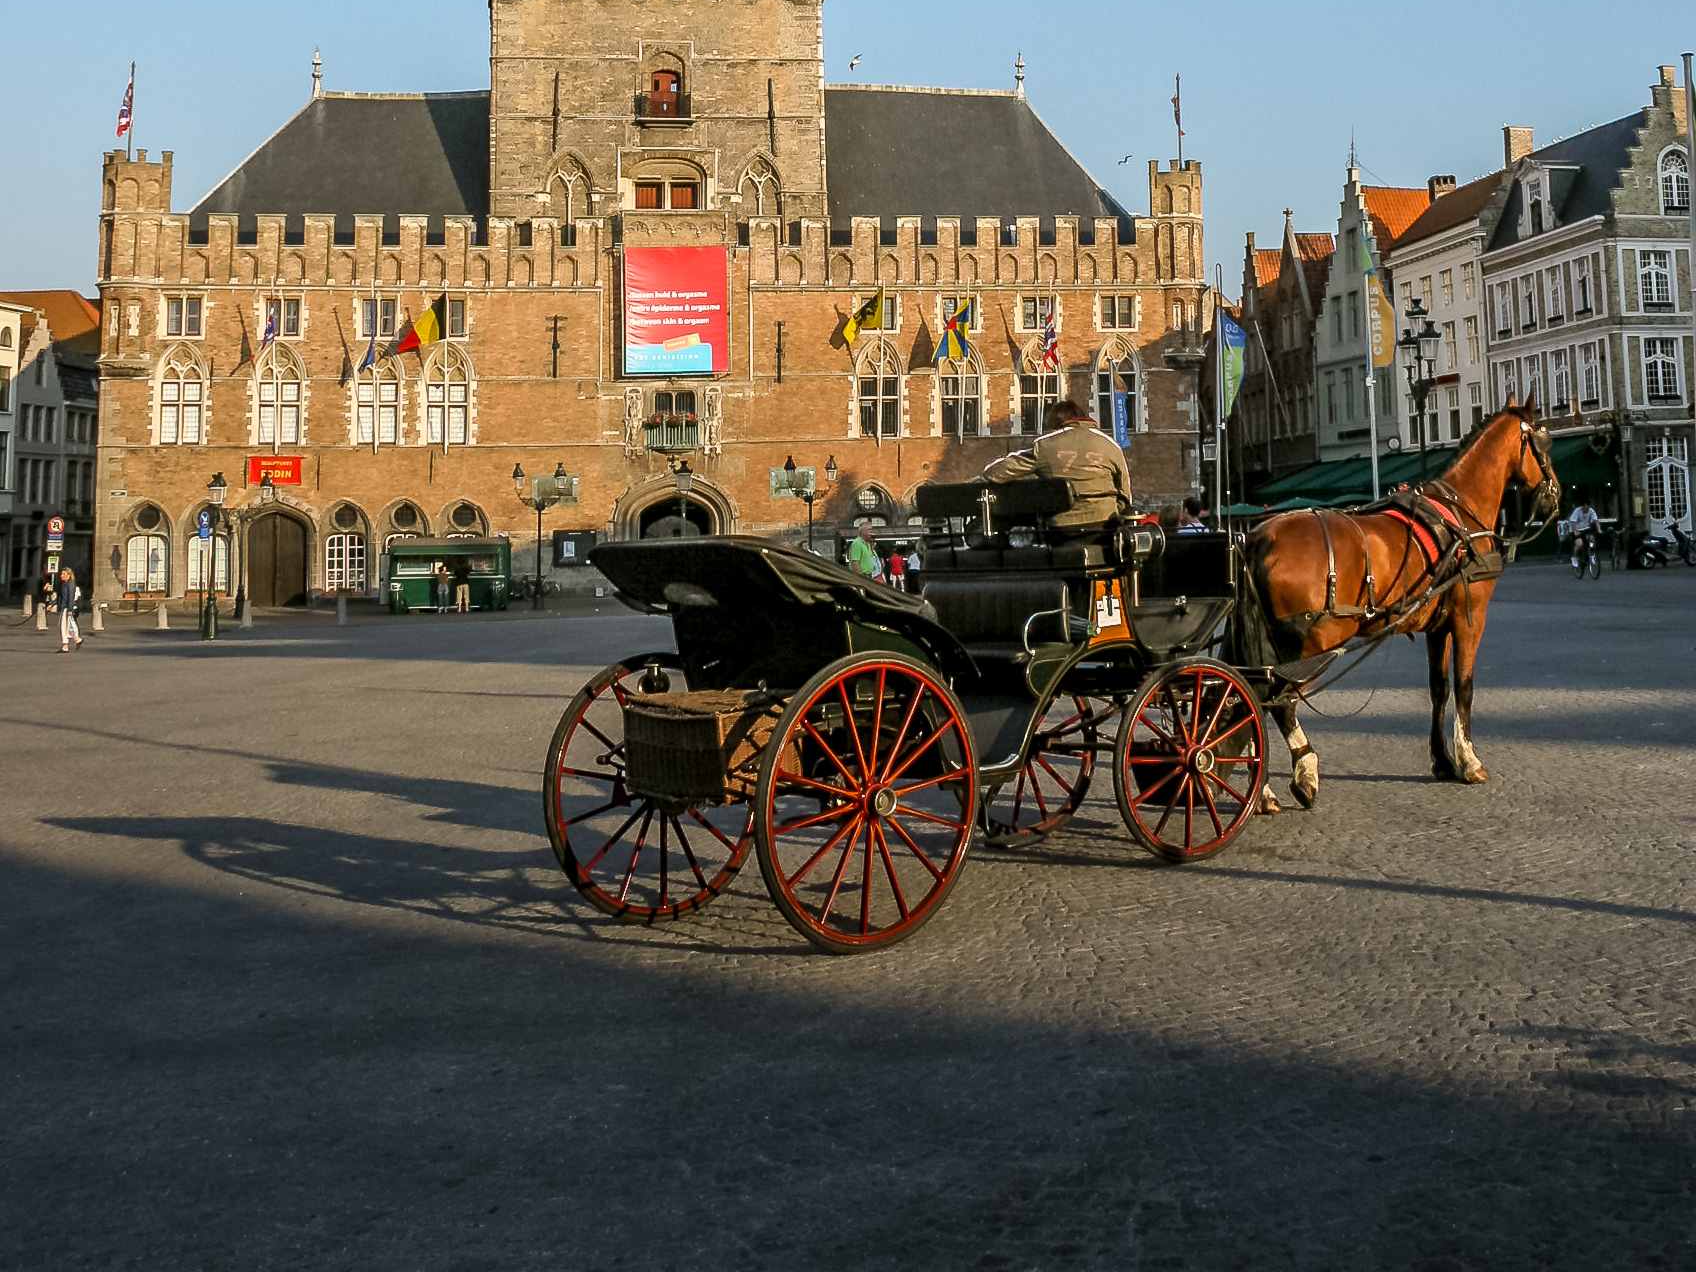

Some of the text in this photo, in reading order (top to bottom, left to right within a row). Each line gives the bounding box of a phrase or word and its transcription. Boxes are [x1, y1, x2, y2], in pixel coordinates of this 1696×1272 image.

[671, 290, 677, 298] &
[678, 291, 708, 300] orgasme
[684, 304, 690, 312] &
[691, 305, 721, 313] orgasme
[662, 317, 677, 325] skin
[678, 317, 684, 325] &
[684, 318, 710, 326] orgasm
[1370, 286, 1384, 356] CORPUS
